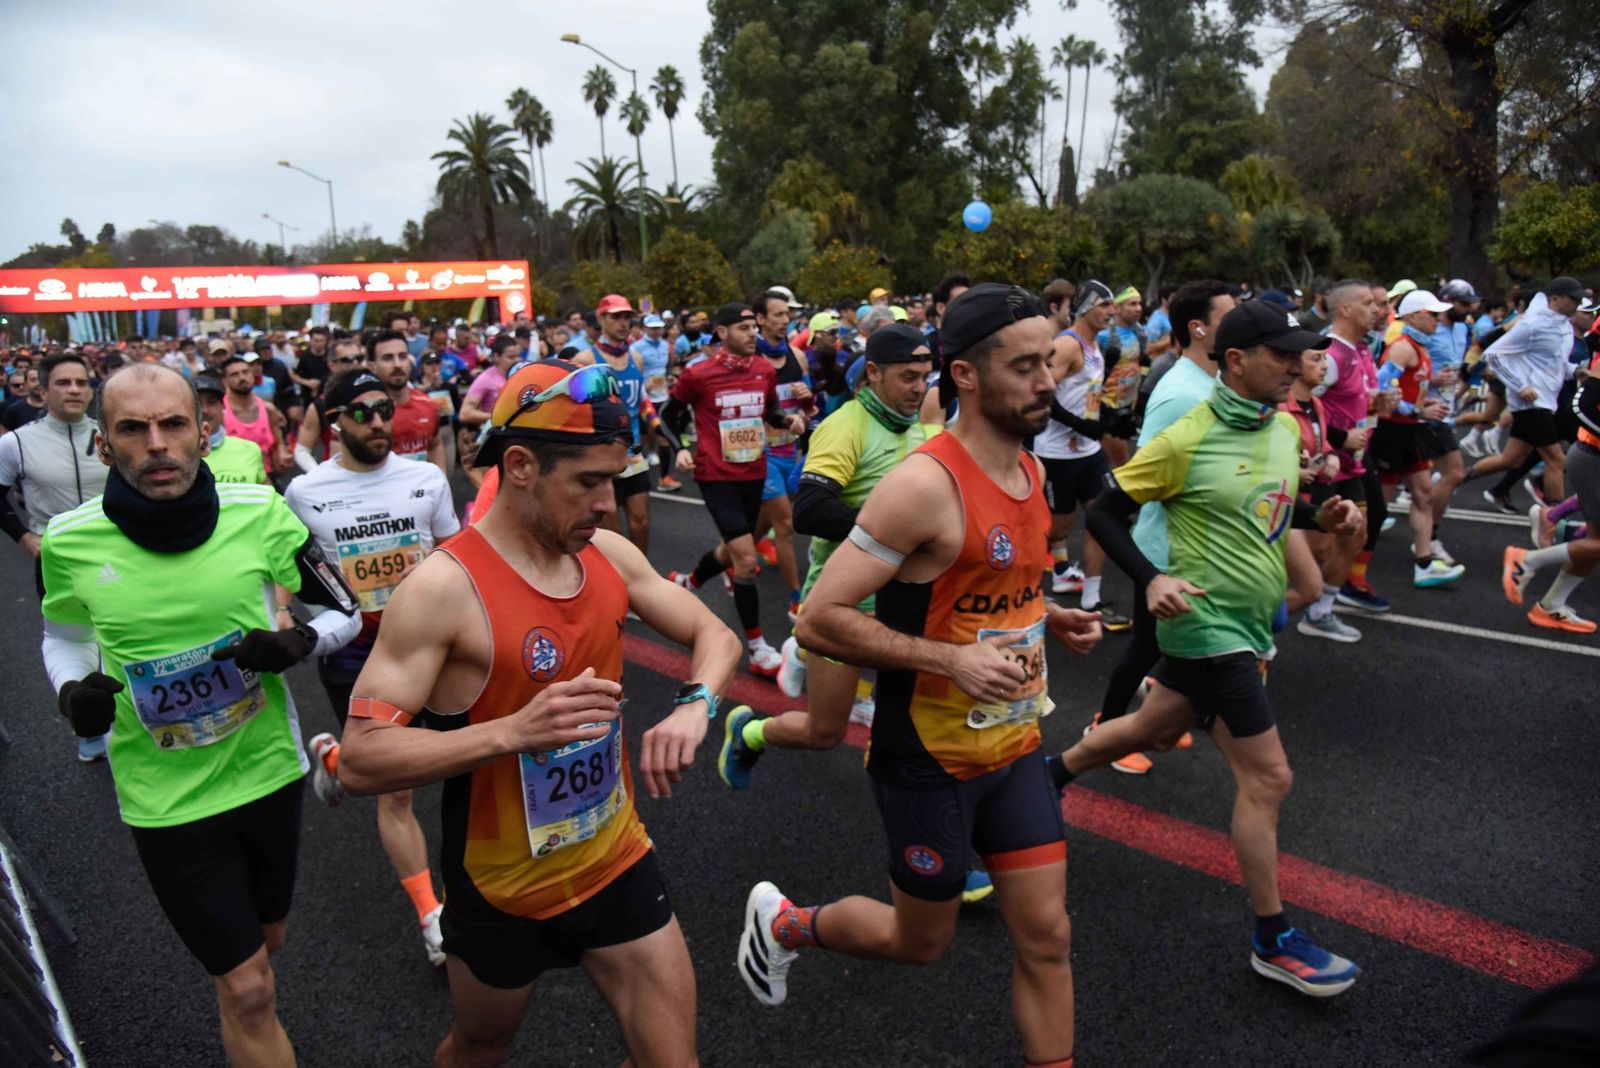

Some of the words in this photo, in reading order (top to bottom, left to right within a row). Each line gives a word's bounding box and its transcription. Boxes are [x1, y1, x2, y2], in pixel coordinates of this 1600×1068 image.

[729, 429, 756, 443] 6602
[334, 516, 416, 543] MARATHON
[355, 512, 391, 523] VALENCIA
[354, 553, 405, 581] 6459
[151, 664, 229, 715] 2361
[546, 743, 612, 803] 2681
